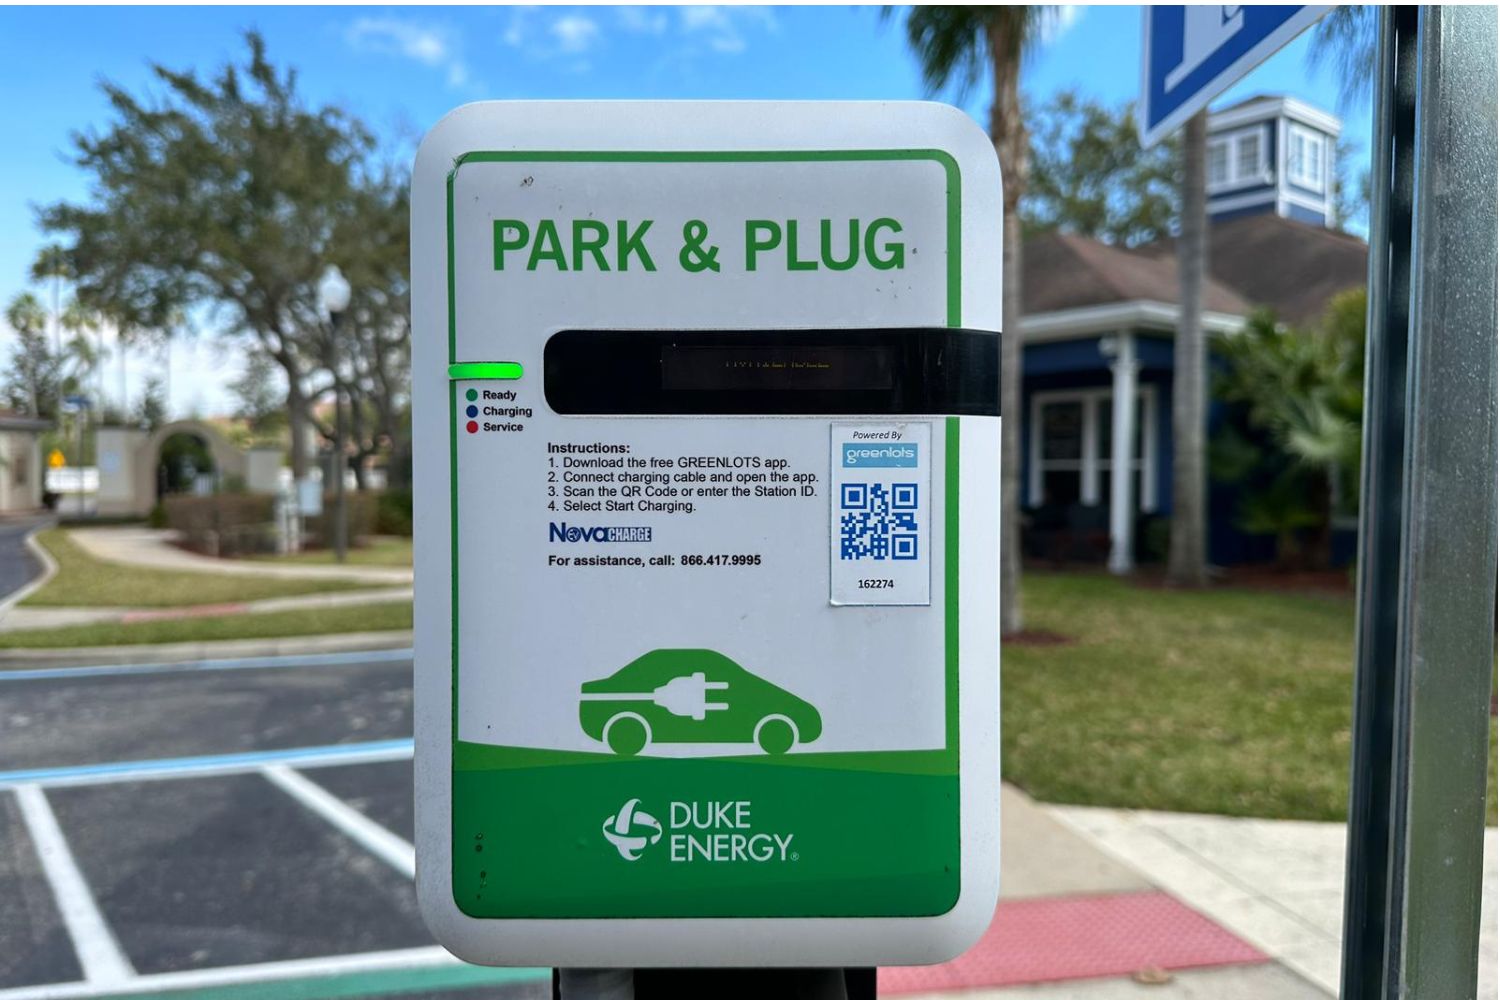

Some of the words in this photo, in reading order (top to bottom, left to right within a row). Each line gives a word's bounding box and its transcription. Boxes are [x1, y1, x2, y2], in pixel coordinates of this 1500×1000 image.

[493, 219, 658, 272] PARK
[678, 219, 721, 273] &
[745, 217, 906, 272] PLUG
[483, 390, 517, 401] Ready
[483, 406, 533, 418] Charging
[483, 422, 524, 432] Service
[852, 431, 890, 439] Powered
[891, 431, 902, 440] By
[547, 442, 630, 454] Instructions:
[846, 447, 915, 464] greenlots
[548, 457, 559, 468] 1.
[563, 457, 624, 468] Download
[627, 457, 647, 468] the
[650, 457, 674, 468] free
[677, 457, 761, 468] GREENLOTS
[764, 459, 791, 470] app.
[547, 471, 559, 483] 2.
[563, 471, 615, 483] Connect
[617, 472, 670, 485] charging
[673, 472, 706, 482] cable
[710, 472, 733, 482] and
[736, 473, 767, 484] open
[770, 472, 789, 482] the
[792, 473, 819, 484] app.
[547, 486, 559, 497] 3.
[563, 486, 595, 497] Scan
[598, 486, 617, 497] the
[621, 486, 641, 497] QR
[645, 486, 678, 497] Code
[681, 487, 694, 497] or
[697, 487, 729, 497] enter
[731, 486, 751, 497] the
[754, 486, 797, 497] Station
[800, 486, 818, 497] ID.
[547, 500, 560, 511] 4.
[563, 500, 602, 511] Select
[605, 500, 635, 511] Start
[637, 500, 697, 513] Charging.
[548, 555, 571, 566] For
[573, 555, 646, 567] assistance,
[649, 555, 675, 566] call:
[680, 555, 762, 566] 866.417.9995
[858, 579, 894, 589] 162274
[670, 801, 751, 829] DUKE
